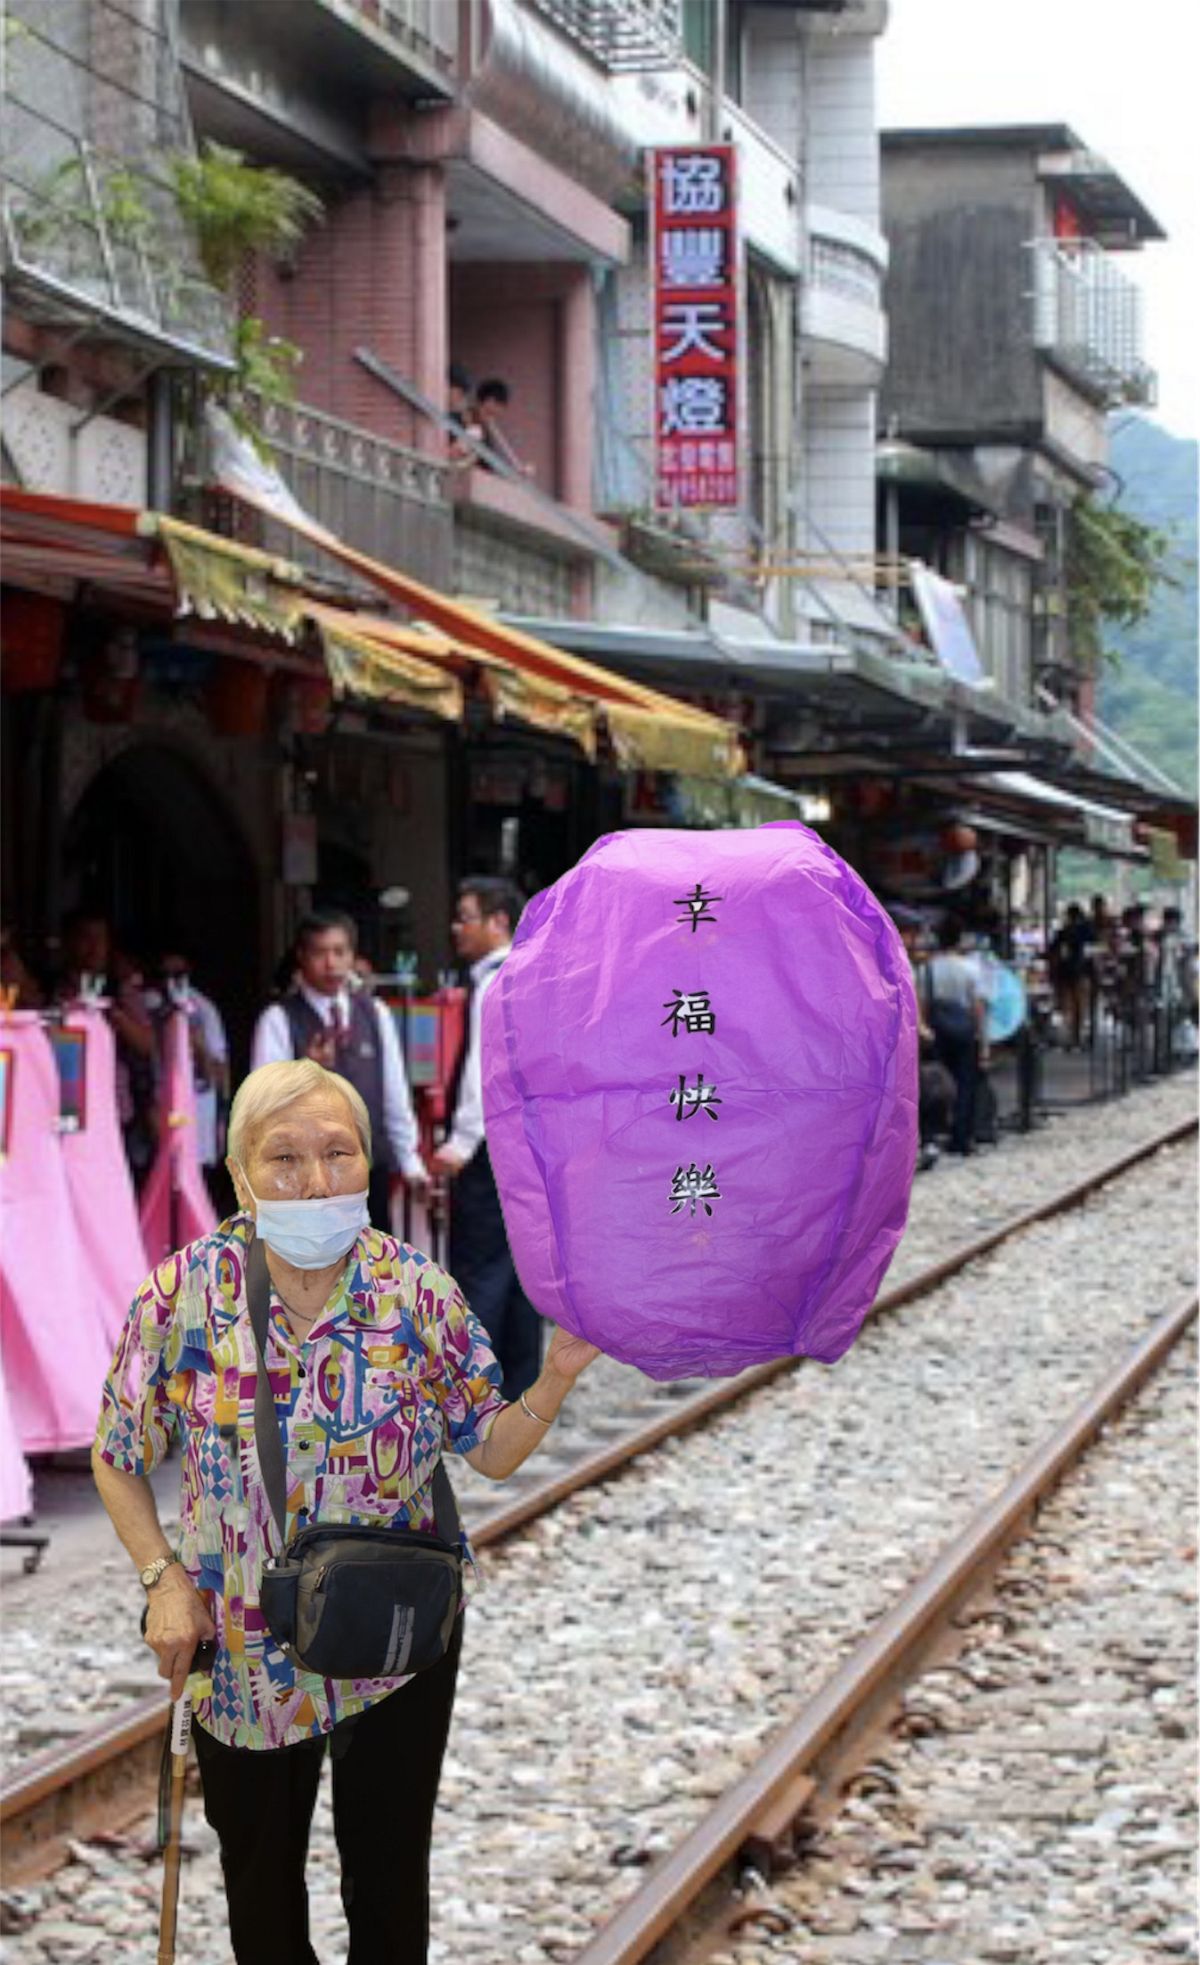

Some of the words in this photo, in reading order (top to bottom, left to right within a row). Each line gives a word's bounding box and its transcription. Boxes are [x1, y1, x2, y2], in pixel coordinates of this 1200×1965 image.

[660, 156, 726, 436] 協豐天燈
[660, 883, 723, 1218] 幸福快樂
